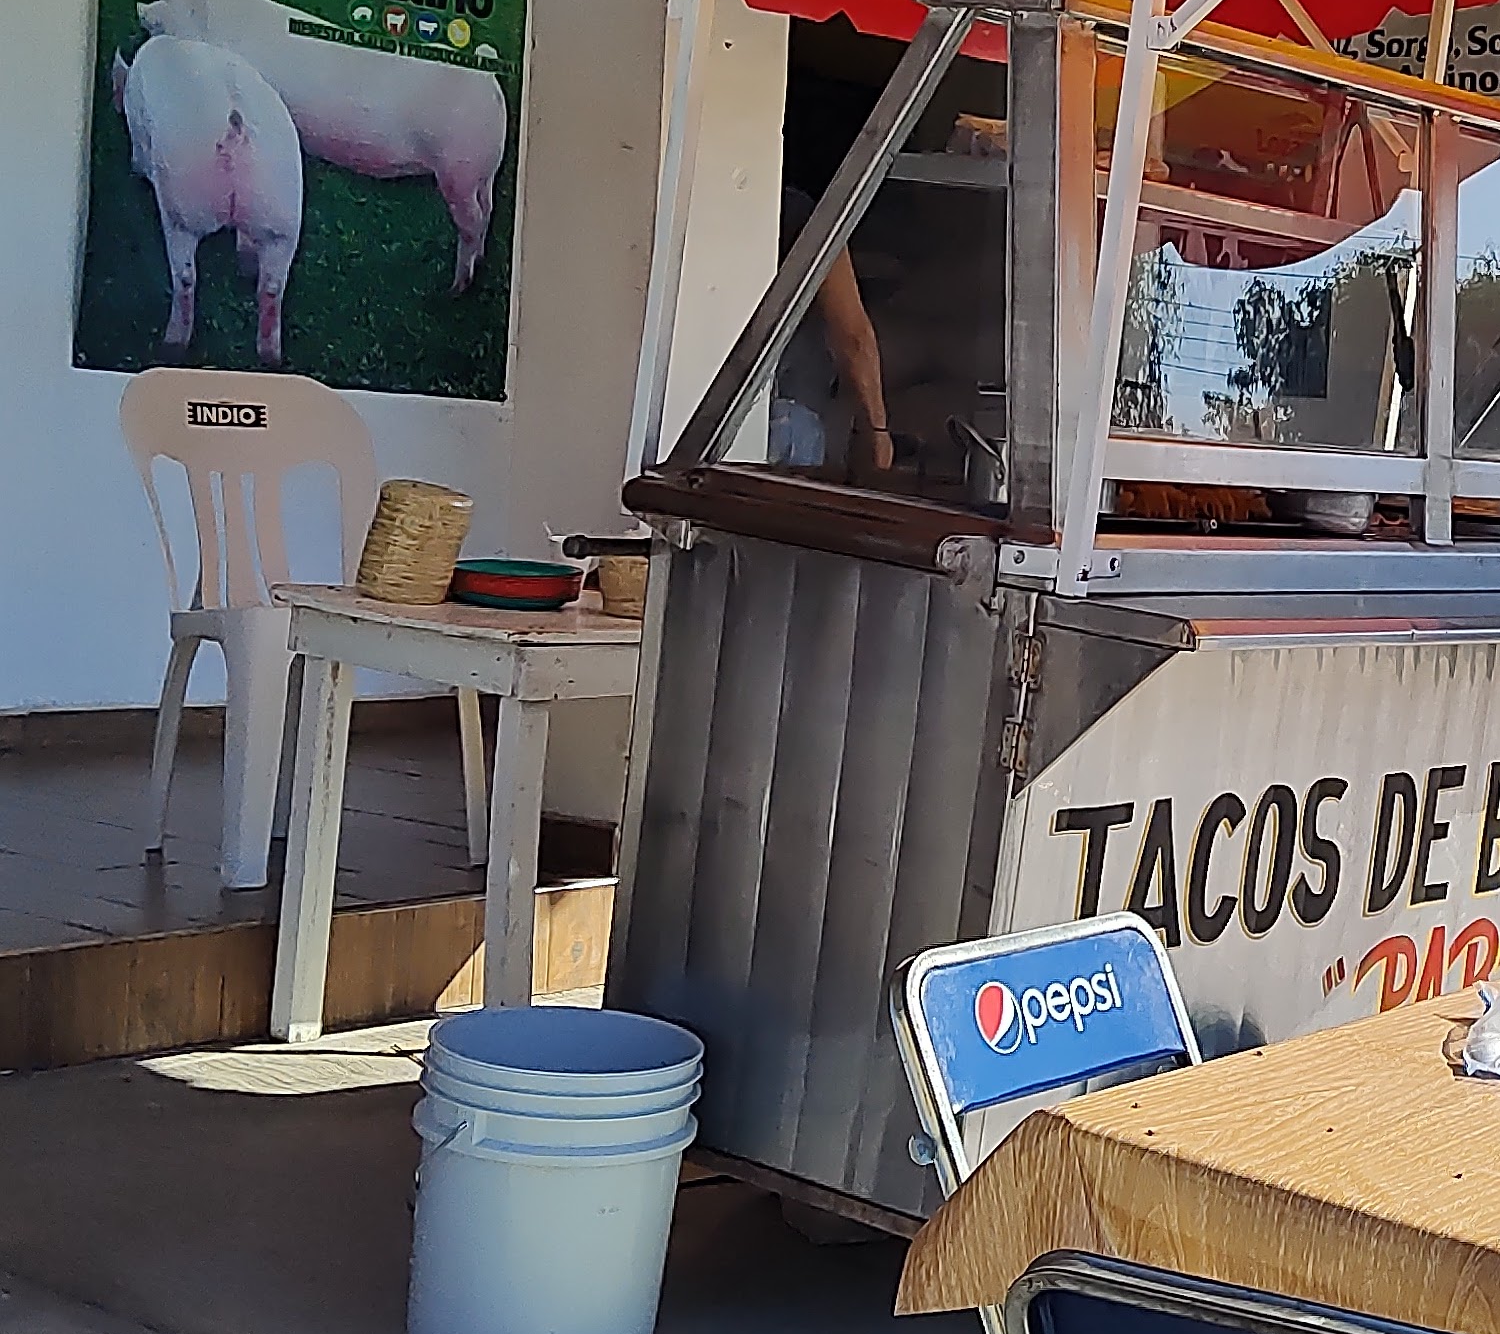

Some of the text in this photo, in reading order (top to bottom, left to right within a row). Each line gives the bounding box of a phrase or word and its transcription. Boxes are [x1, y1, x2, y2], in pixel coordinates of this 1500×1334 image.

[1366, 28, 1461, 63] Sorg,
[196, 405, 256, 425] INDIO
[1049, 776, 1349, 948] TACOS
[1363, 763, 1468, 917] DE
[1022, 962, 1123, 1045] pepsi
